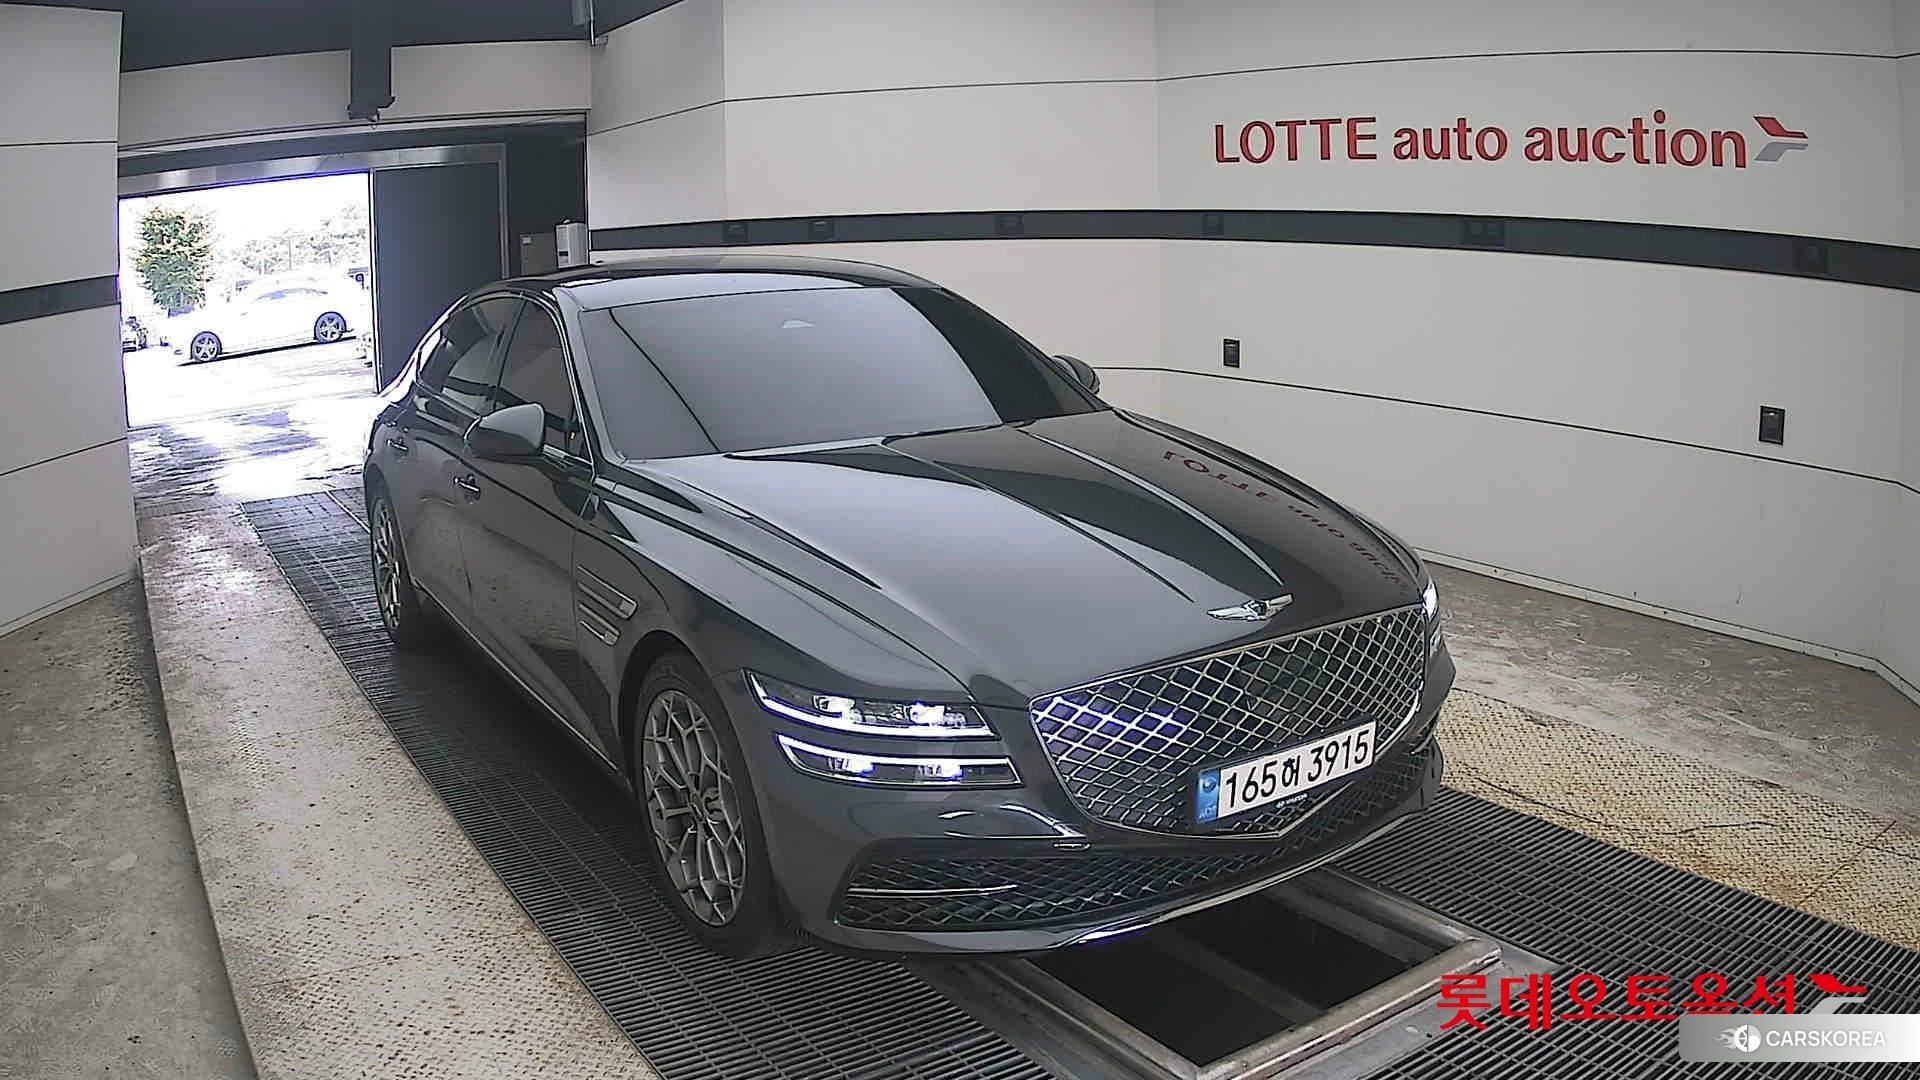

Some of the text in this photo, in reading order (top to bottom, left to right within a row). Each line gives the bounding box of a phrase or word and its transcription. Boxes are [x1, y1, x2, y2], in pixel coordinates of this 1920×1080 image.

[1214, 110, 1747, 168] LOTTE auto auction
[1226, 729, 1370, 809] 165허 3915
